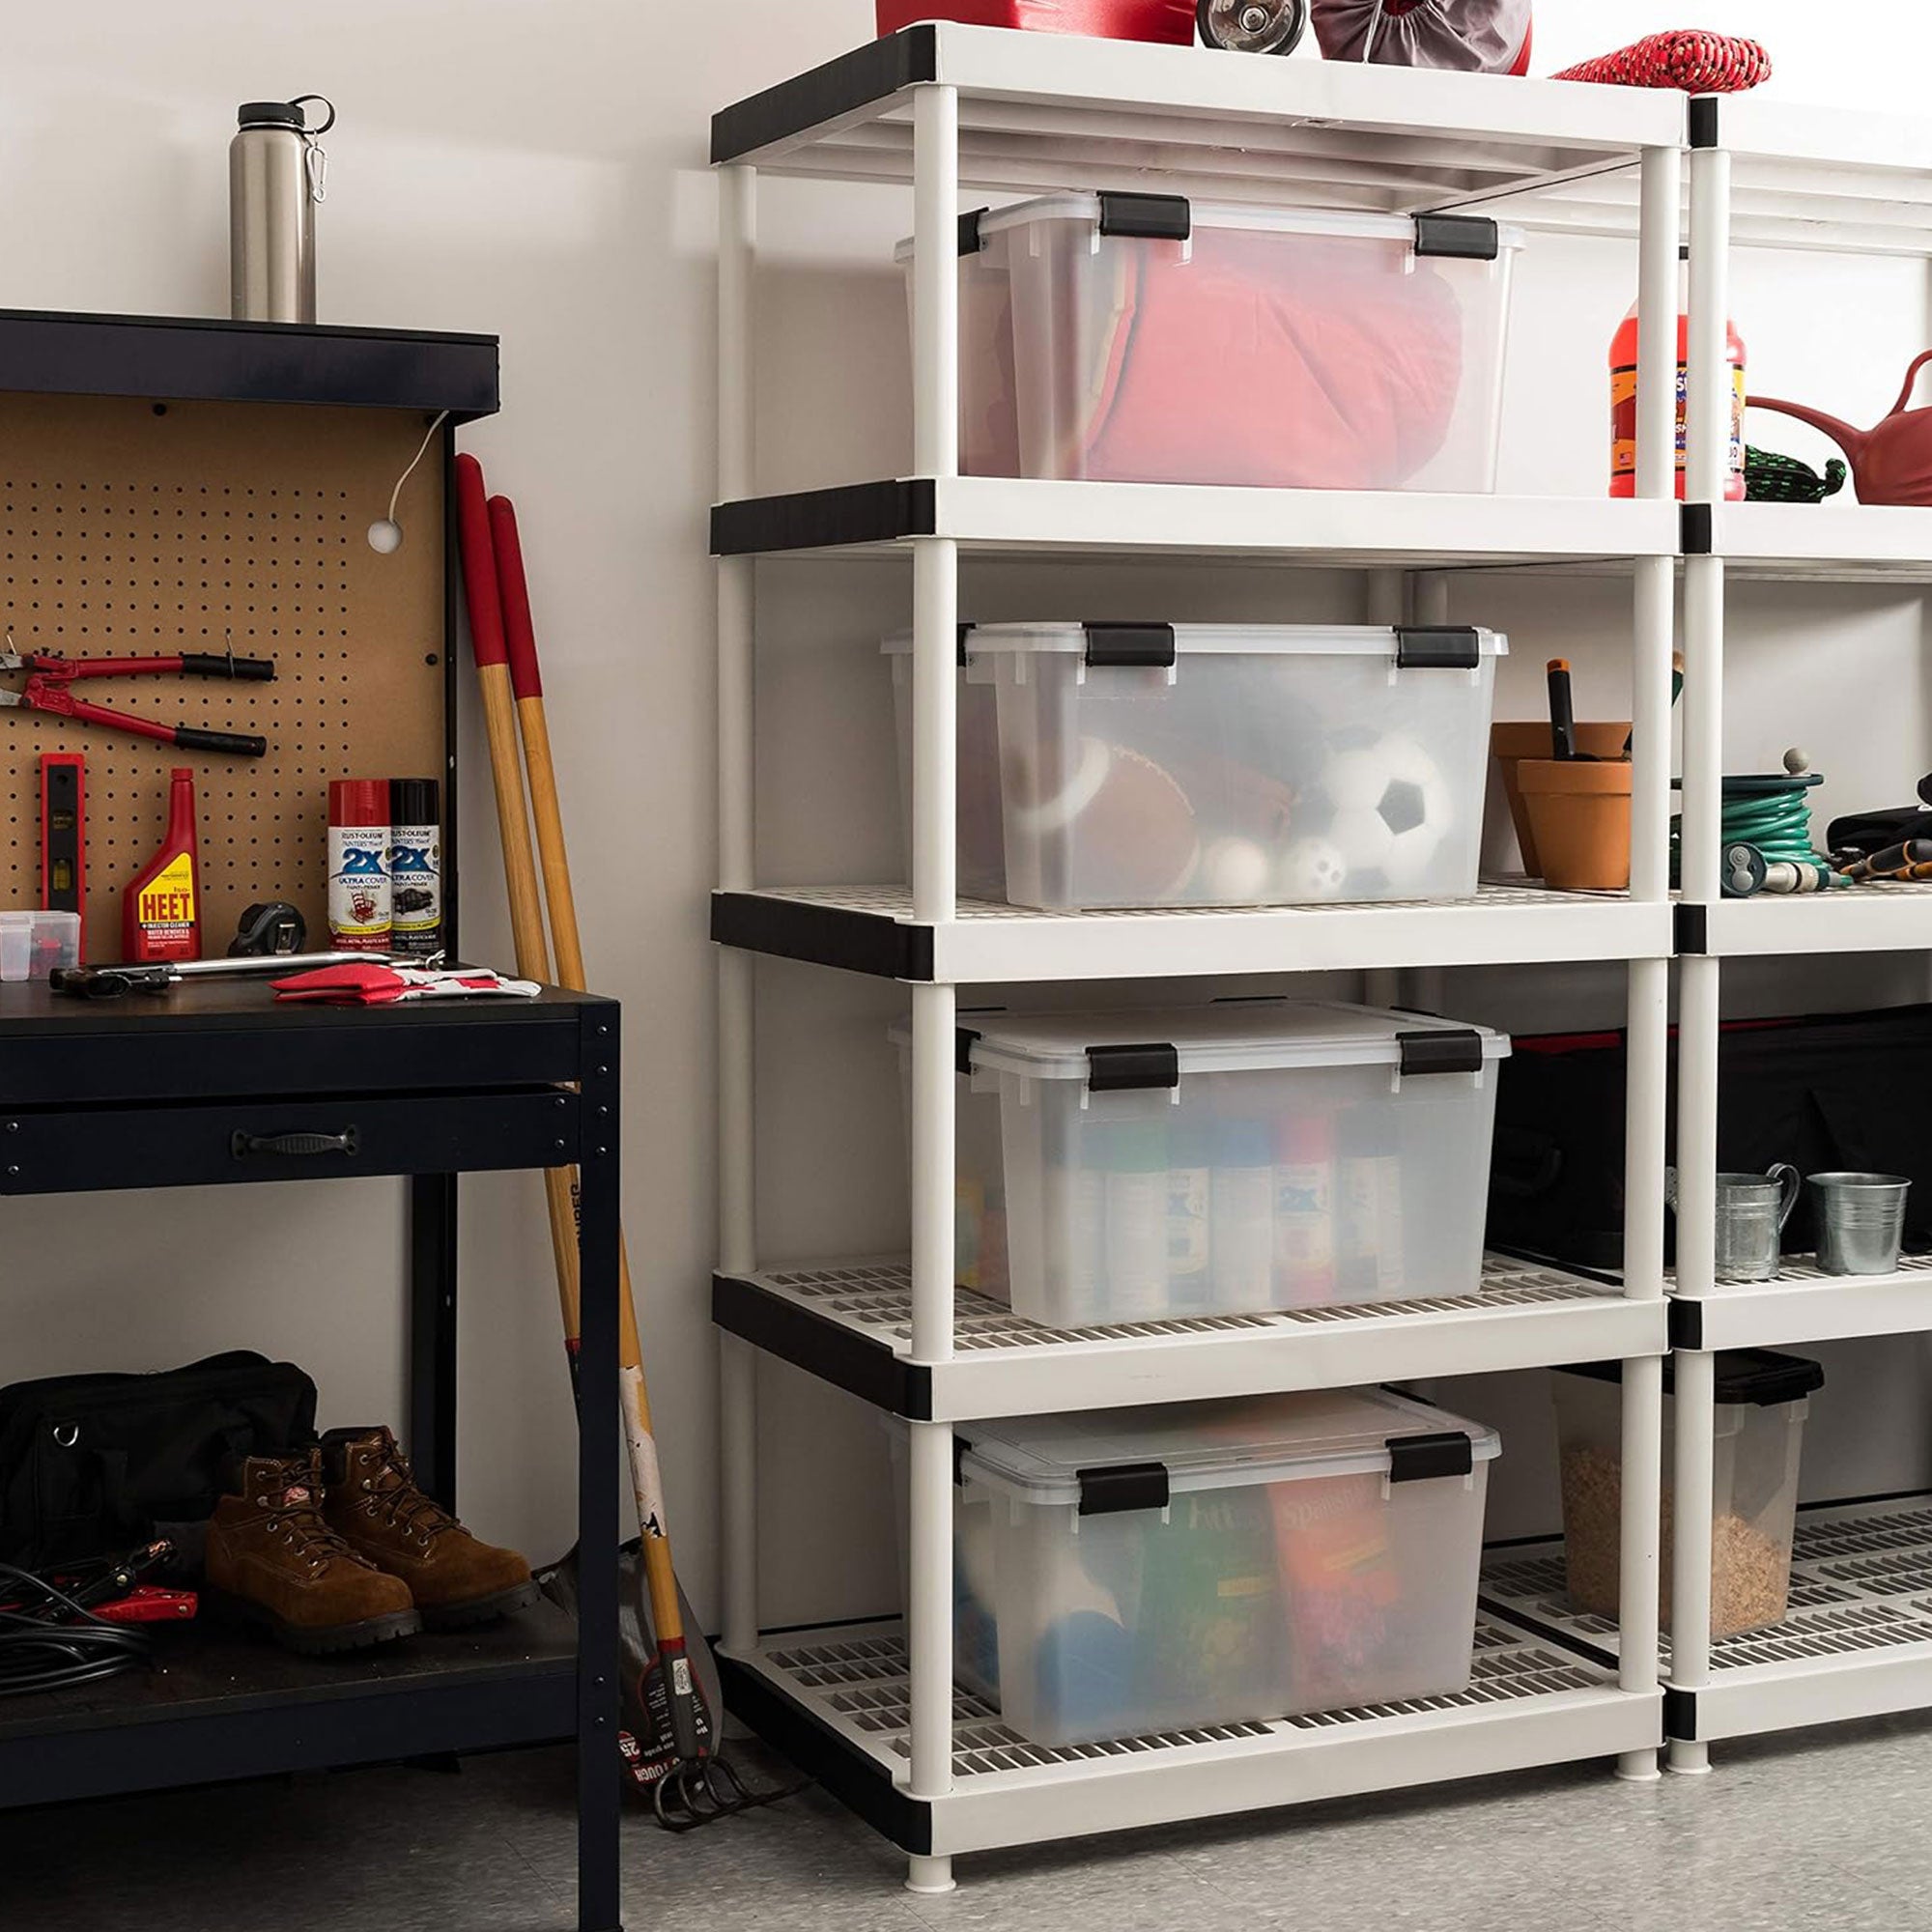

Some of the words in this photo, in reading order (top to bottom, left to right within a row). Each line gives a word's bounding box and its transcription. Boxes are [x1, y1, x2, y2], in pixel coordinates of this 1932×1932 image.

[343, 847, 384, 874] 2X
[391, 845, 431, 872] 2X
[143, 894, 190, 921] HEET
[619, 1743, 640, 1758] 25
